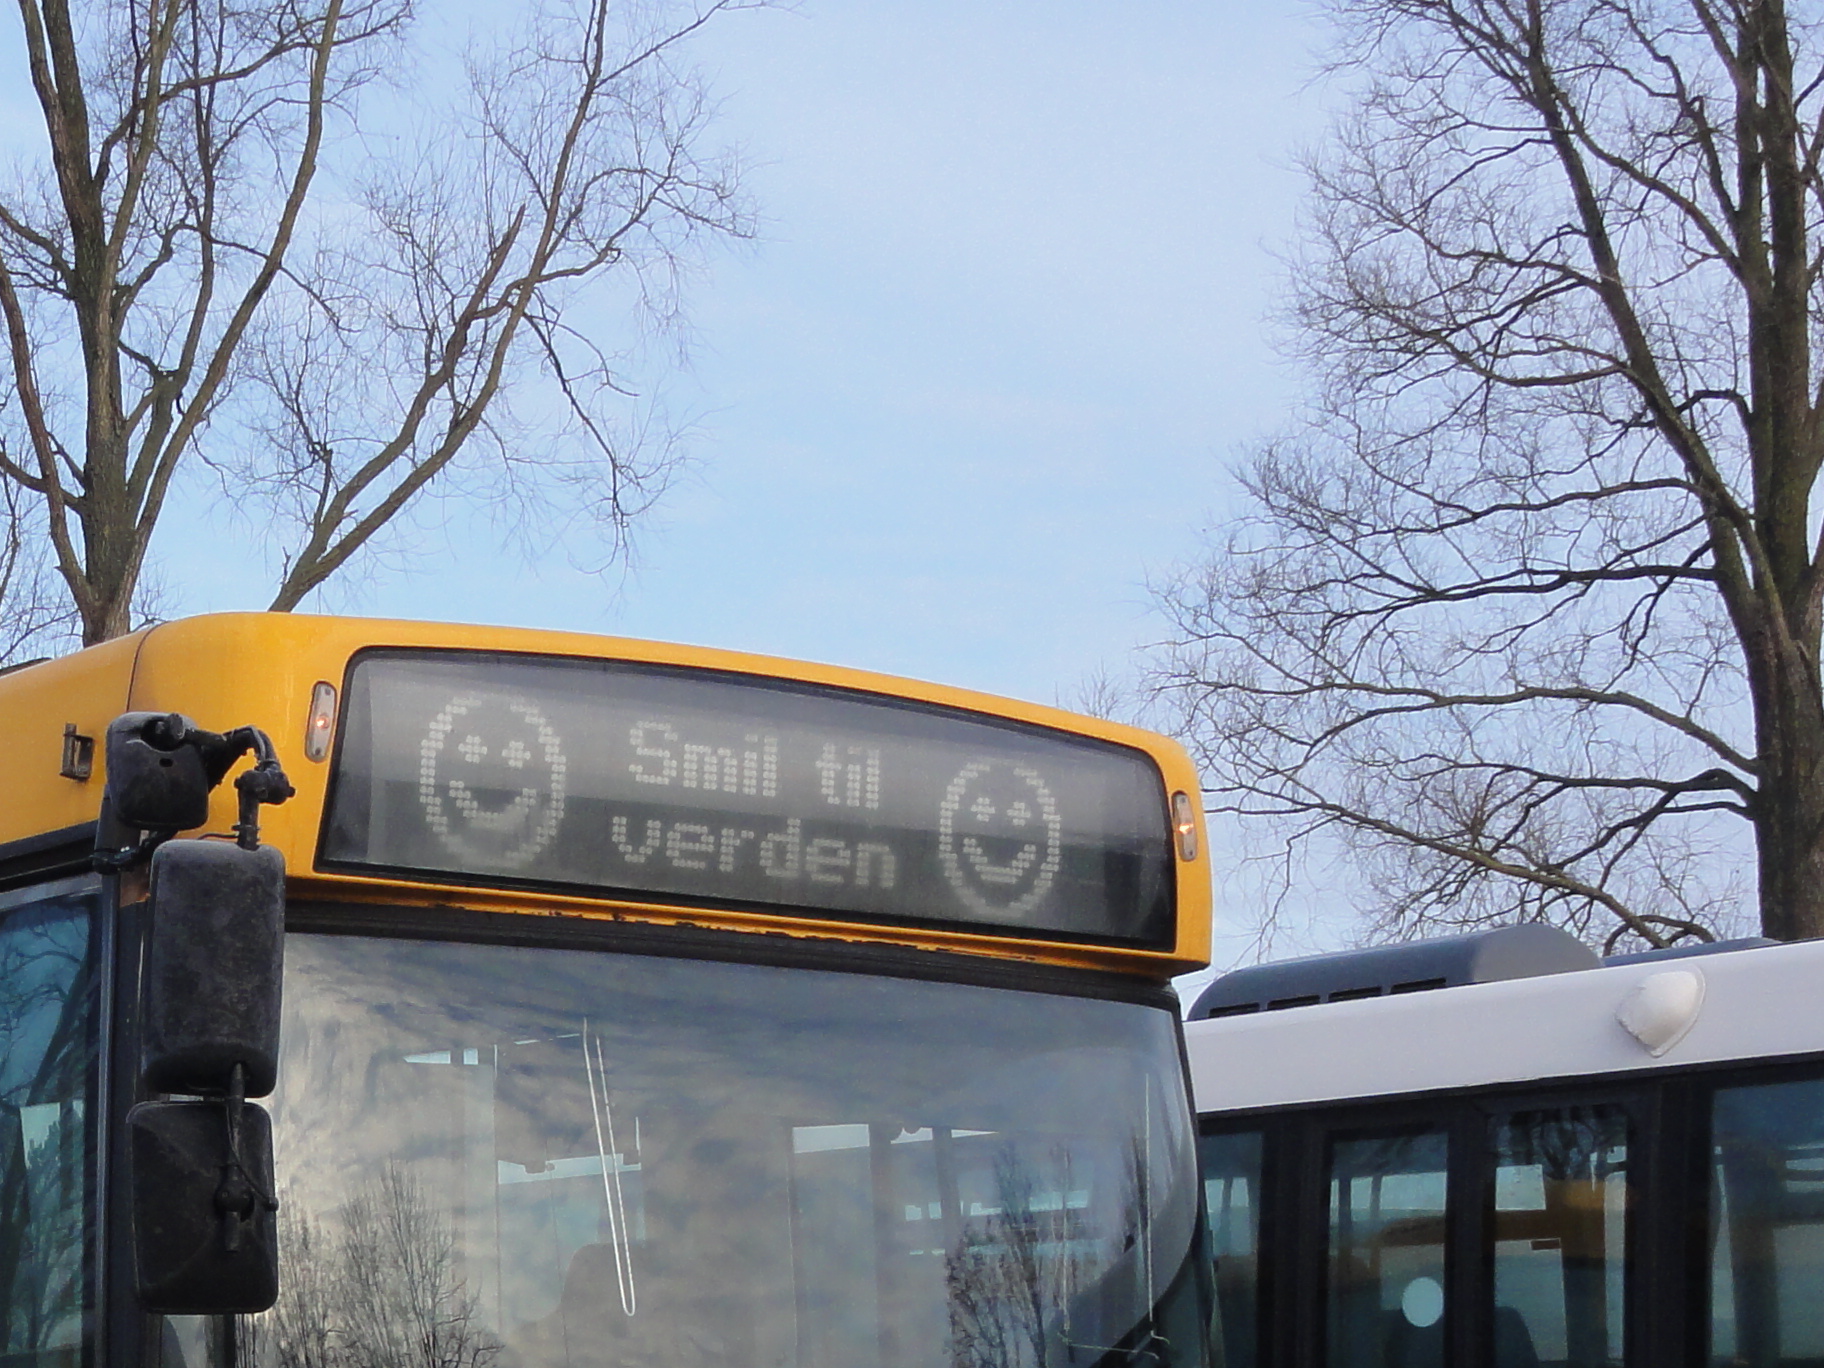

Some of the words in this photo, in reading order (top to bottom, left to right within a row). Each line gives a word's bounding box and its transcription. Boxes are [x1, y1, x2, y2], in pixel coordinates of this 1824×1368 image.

[628, 720, 778, 797] Smil
[815, 742, 880, 809] til
[611, 815, 896, 888] verden
